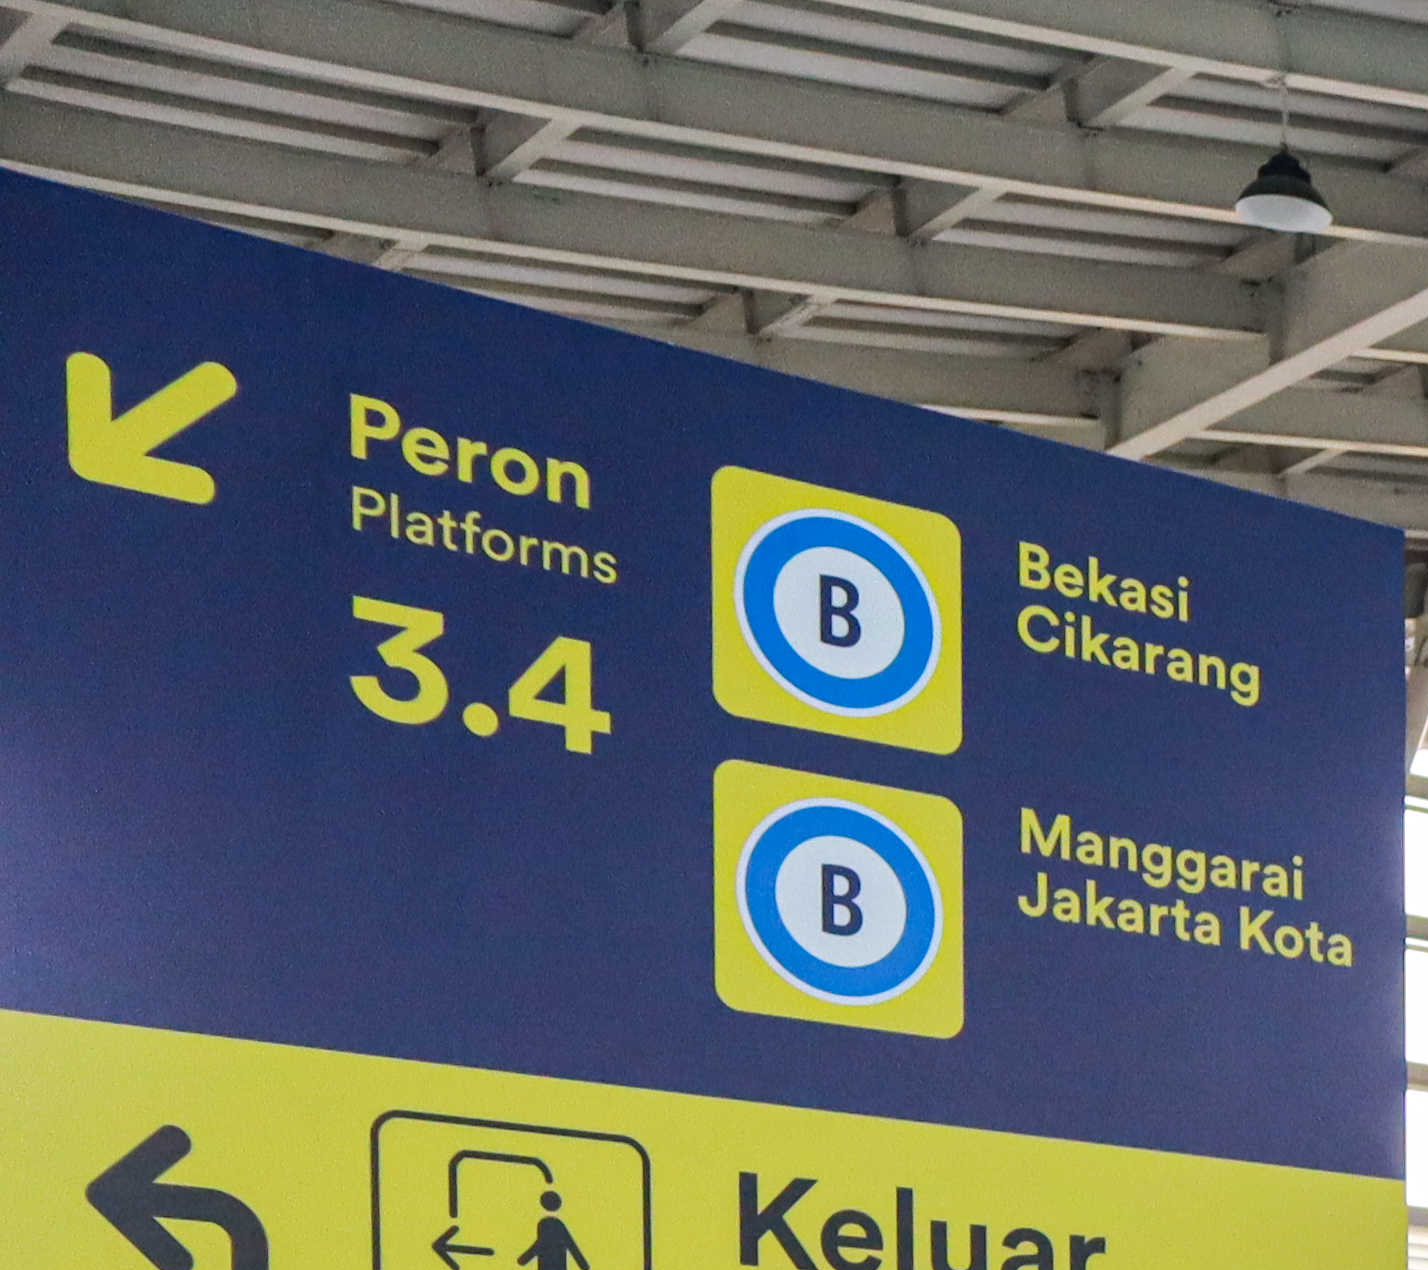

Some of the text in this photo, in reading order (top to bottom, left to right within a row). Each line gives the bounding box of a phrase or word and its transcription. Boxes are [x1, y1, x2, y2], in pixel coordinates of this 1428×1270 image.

[350, 393, 592, 510] Peron
[350, 486, 619, 584] Platforms
[820, 575, 861, 647] B
[1018, 543, 1189, 621] Bekasi
[1018, 606, 1260, 706] Cikarang
[822, 864, 863, 936] B
[1020, 808, 1303, 900] Manggarai
[1018, 873, 1352, 967] Jakarta Kota
